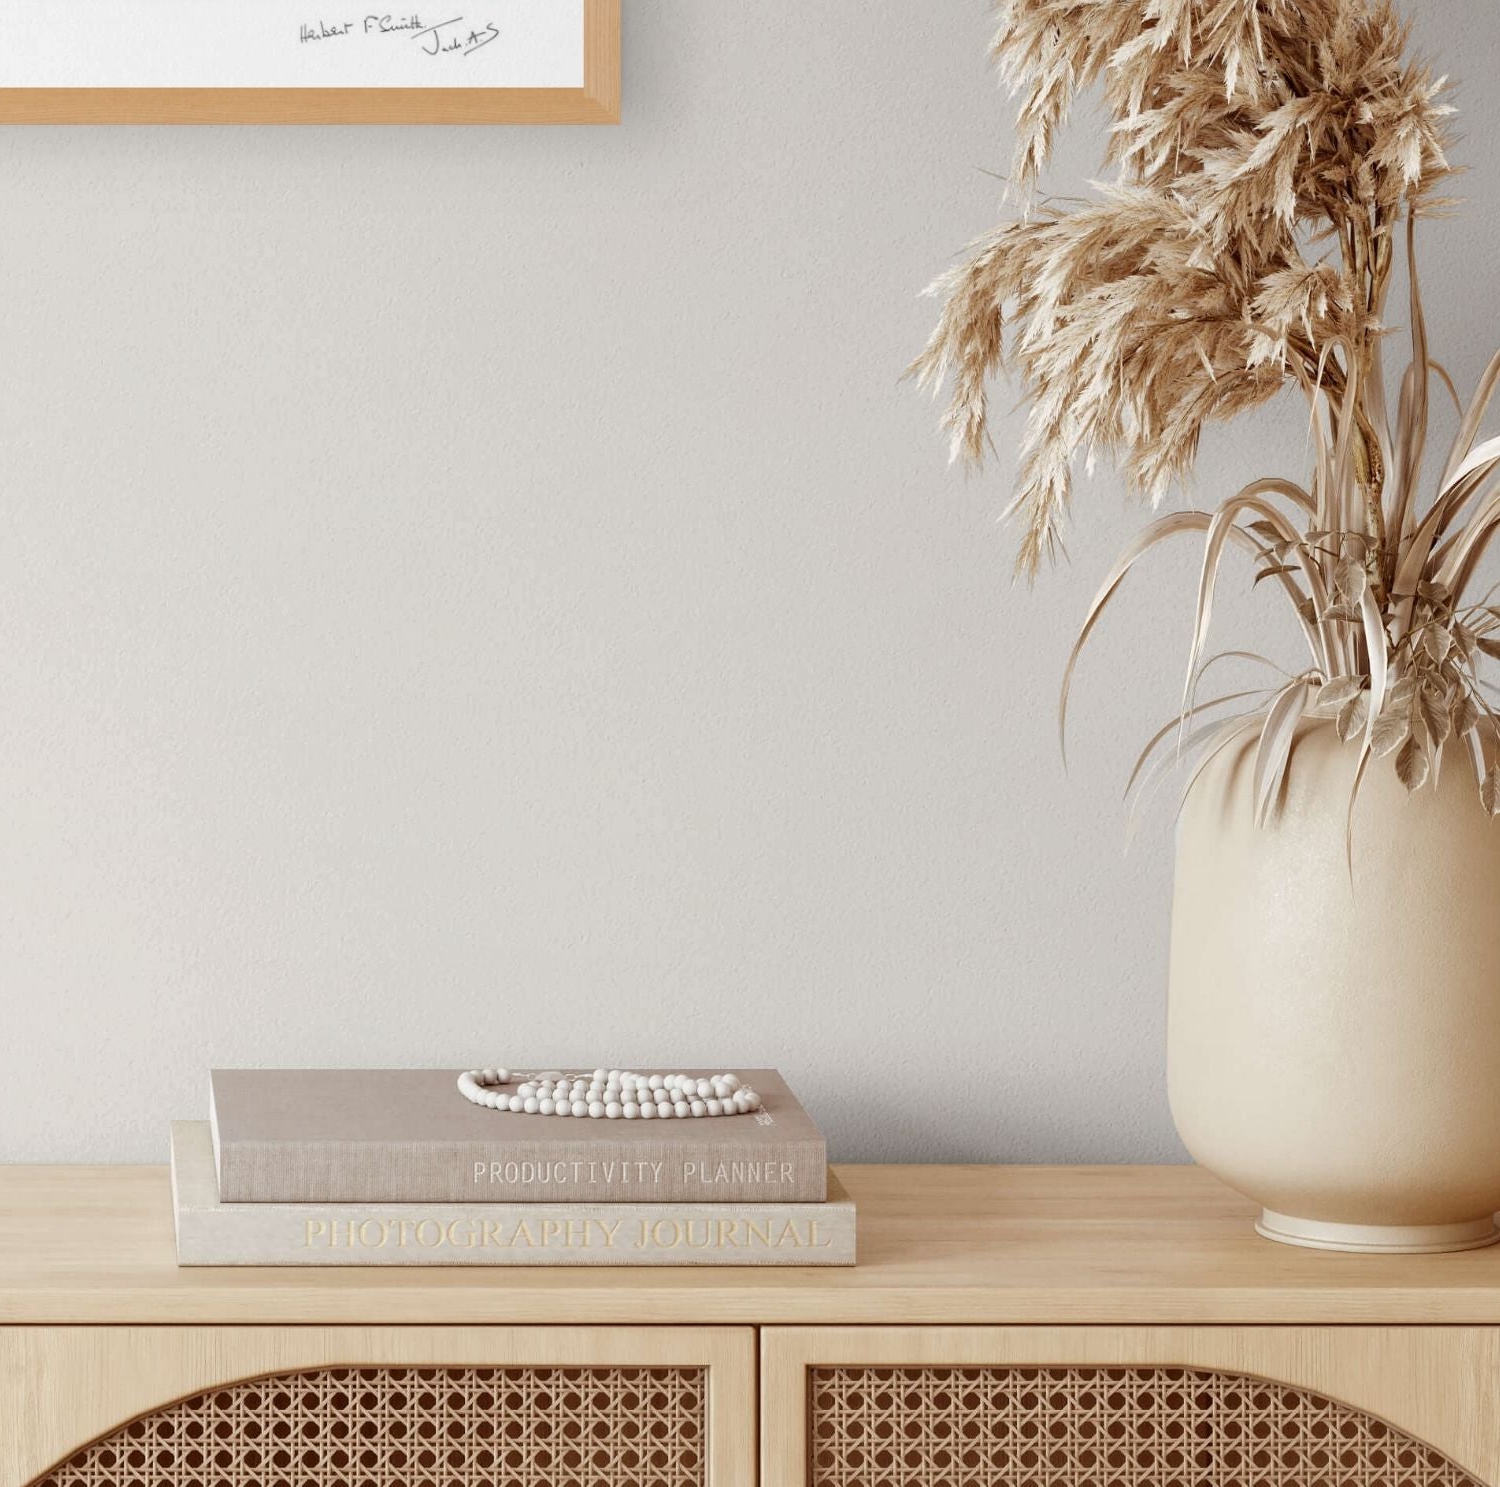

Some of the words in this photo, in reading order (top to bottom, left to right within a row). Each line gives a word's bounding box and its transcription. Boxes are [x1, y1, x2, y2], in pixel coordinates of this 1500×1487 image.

[472, 1161, 664, 1184] PRODUCTIVITY
[682, 1161, 795, 1184] PLANNER
[302, 1216, 624, 1249] PHOTOGRAPHY
[633, 1216, 832, 1250] JOURNAL
